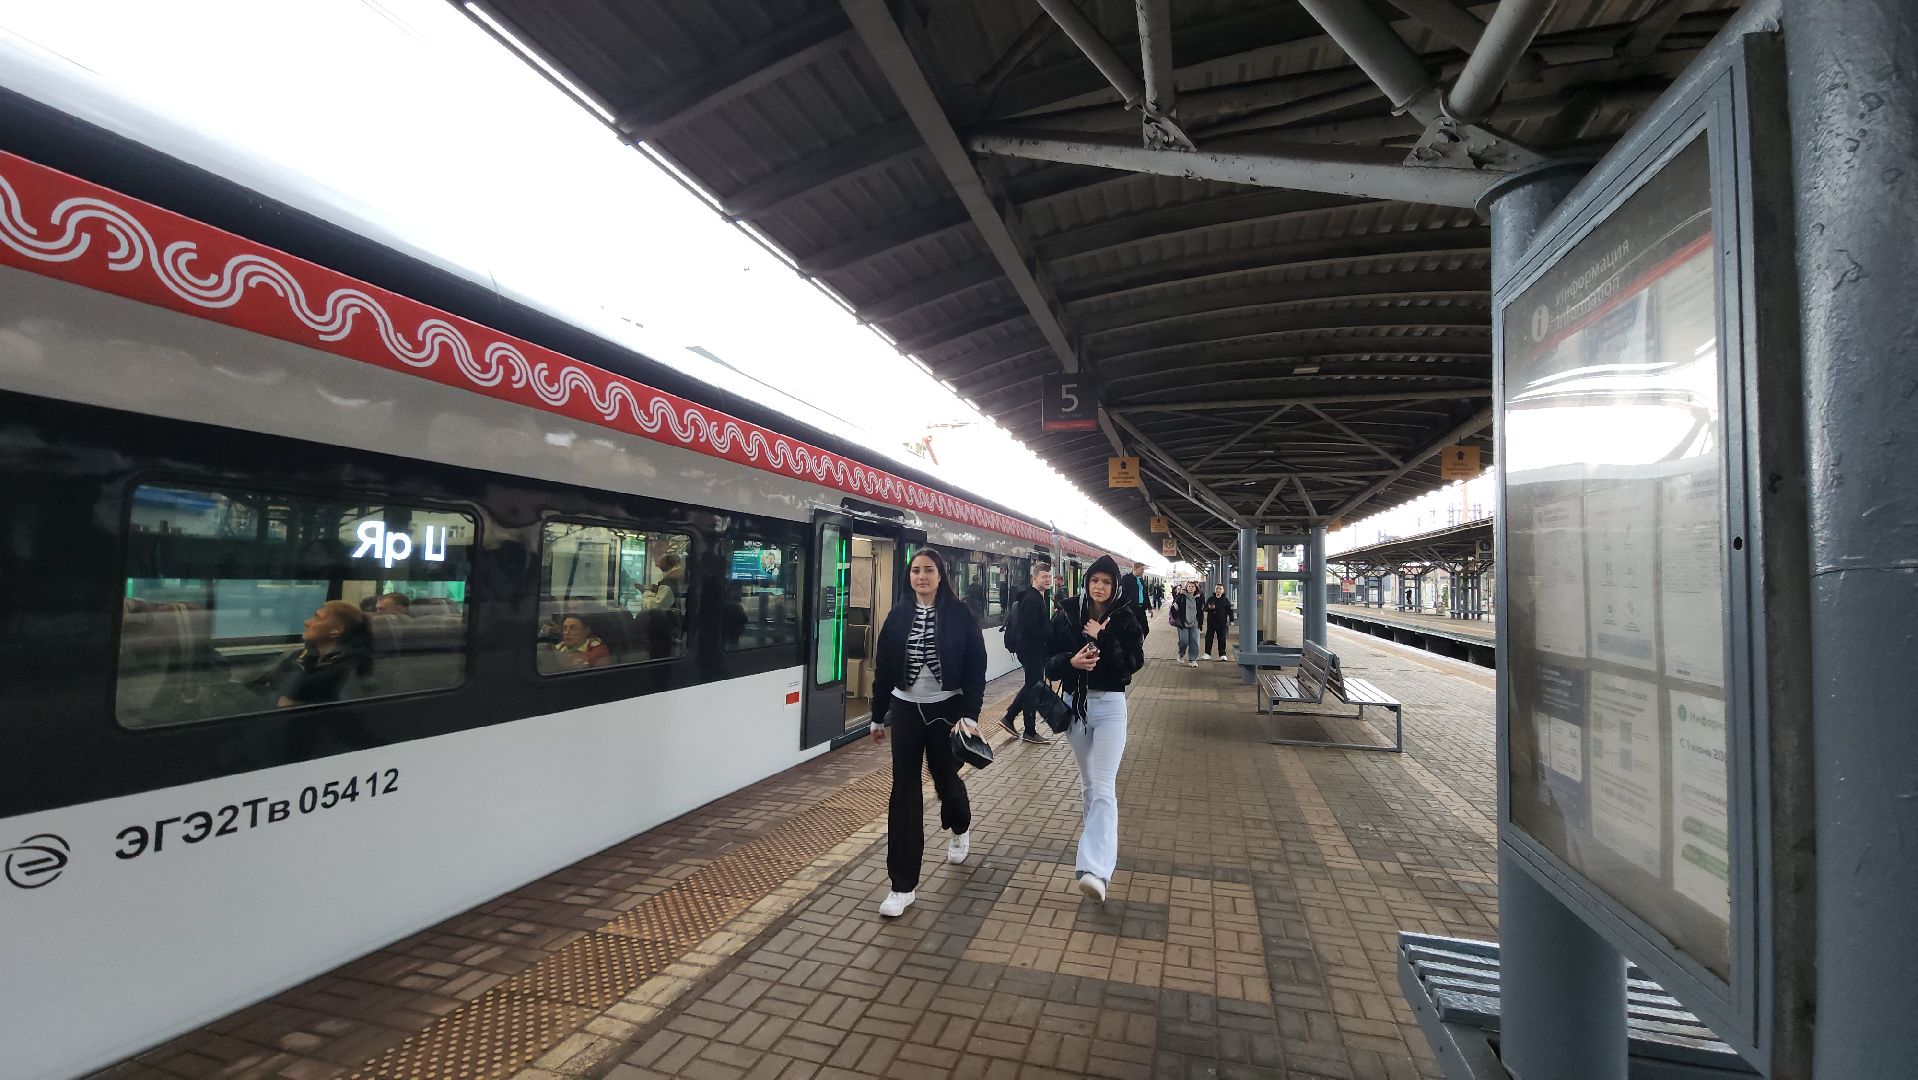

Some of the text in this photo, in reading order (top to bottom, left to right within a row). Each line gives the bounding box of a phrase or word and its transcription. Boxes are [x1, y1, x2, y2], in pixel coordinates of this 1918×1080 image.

[1556, 239, 1629, 305] Информация
[1061, 383, 1079, 413] 5
[352, 520, 412, 569] Яр
[115, 768, 400, 860] ЭГЭ2Тв 05412
